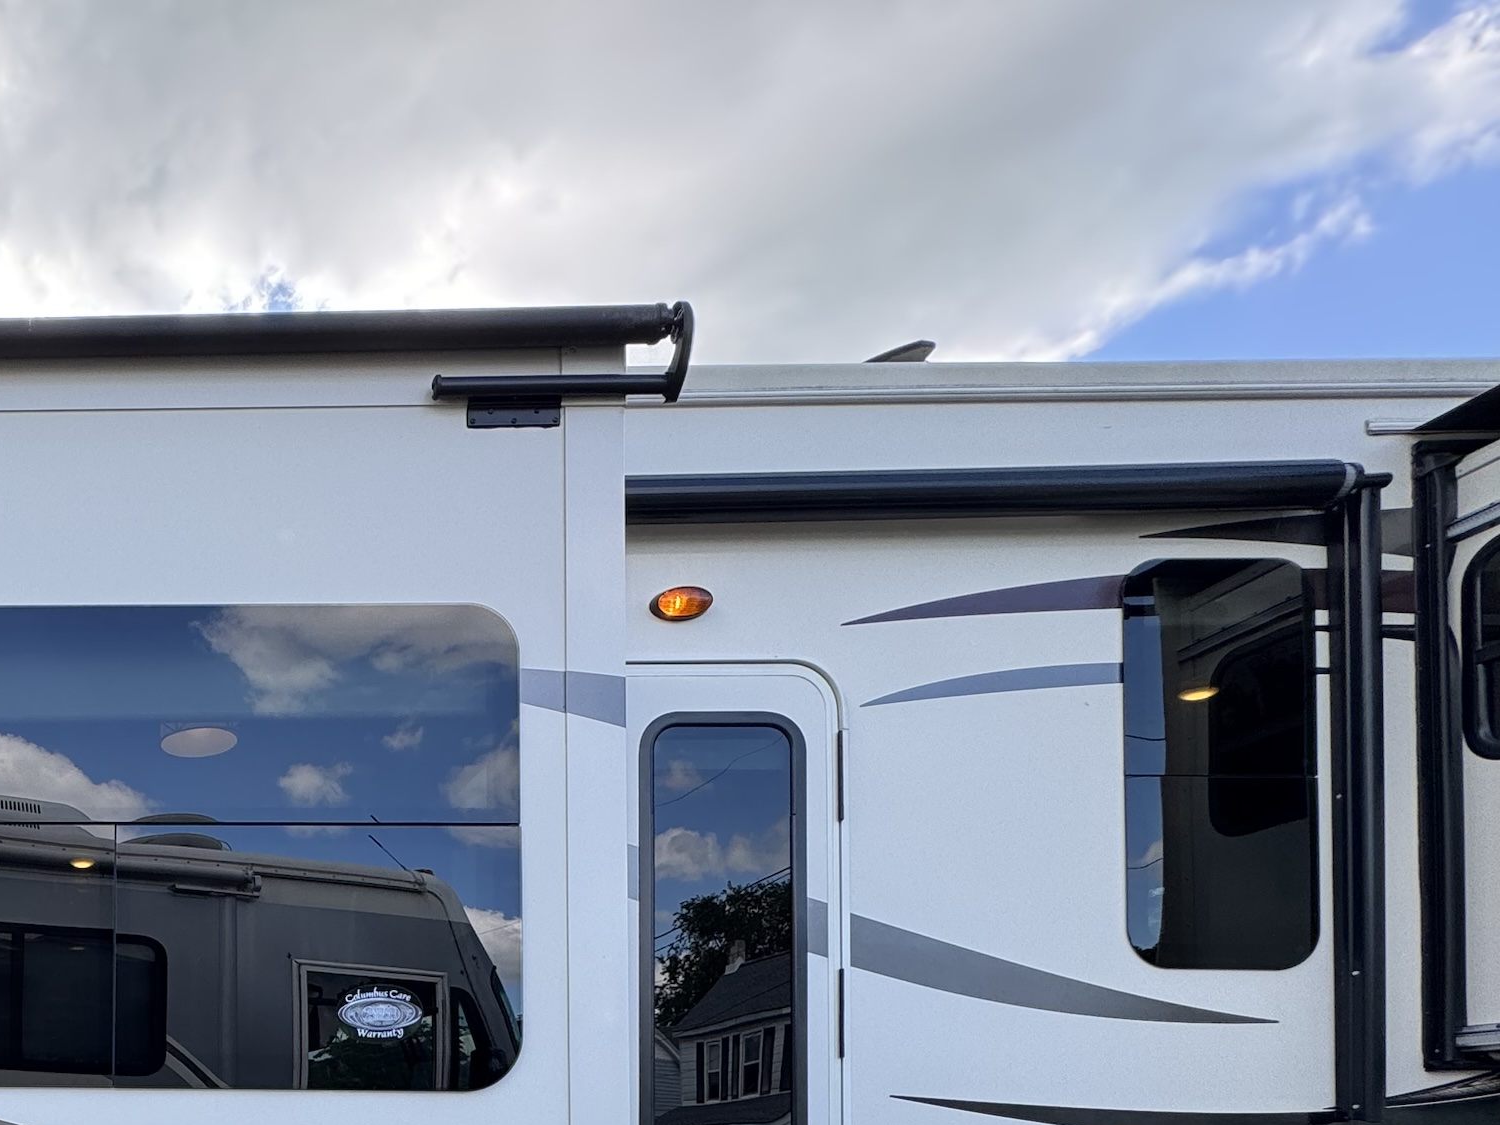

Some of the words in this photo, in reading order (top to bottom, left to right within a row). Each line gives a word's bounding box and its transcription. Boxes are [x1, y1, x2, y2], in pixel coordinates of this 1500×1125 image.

[345, 987, 389, 1002] Columbus
[389, 989, 412, 1002] Care
[356, 1028, 404, 1039] Warranty
